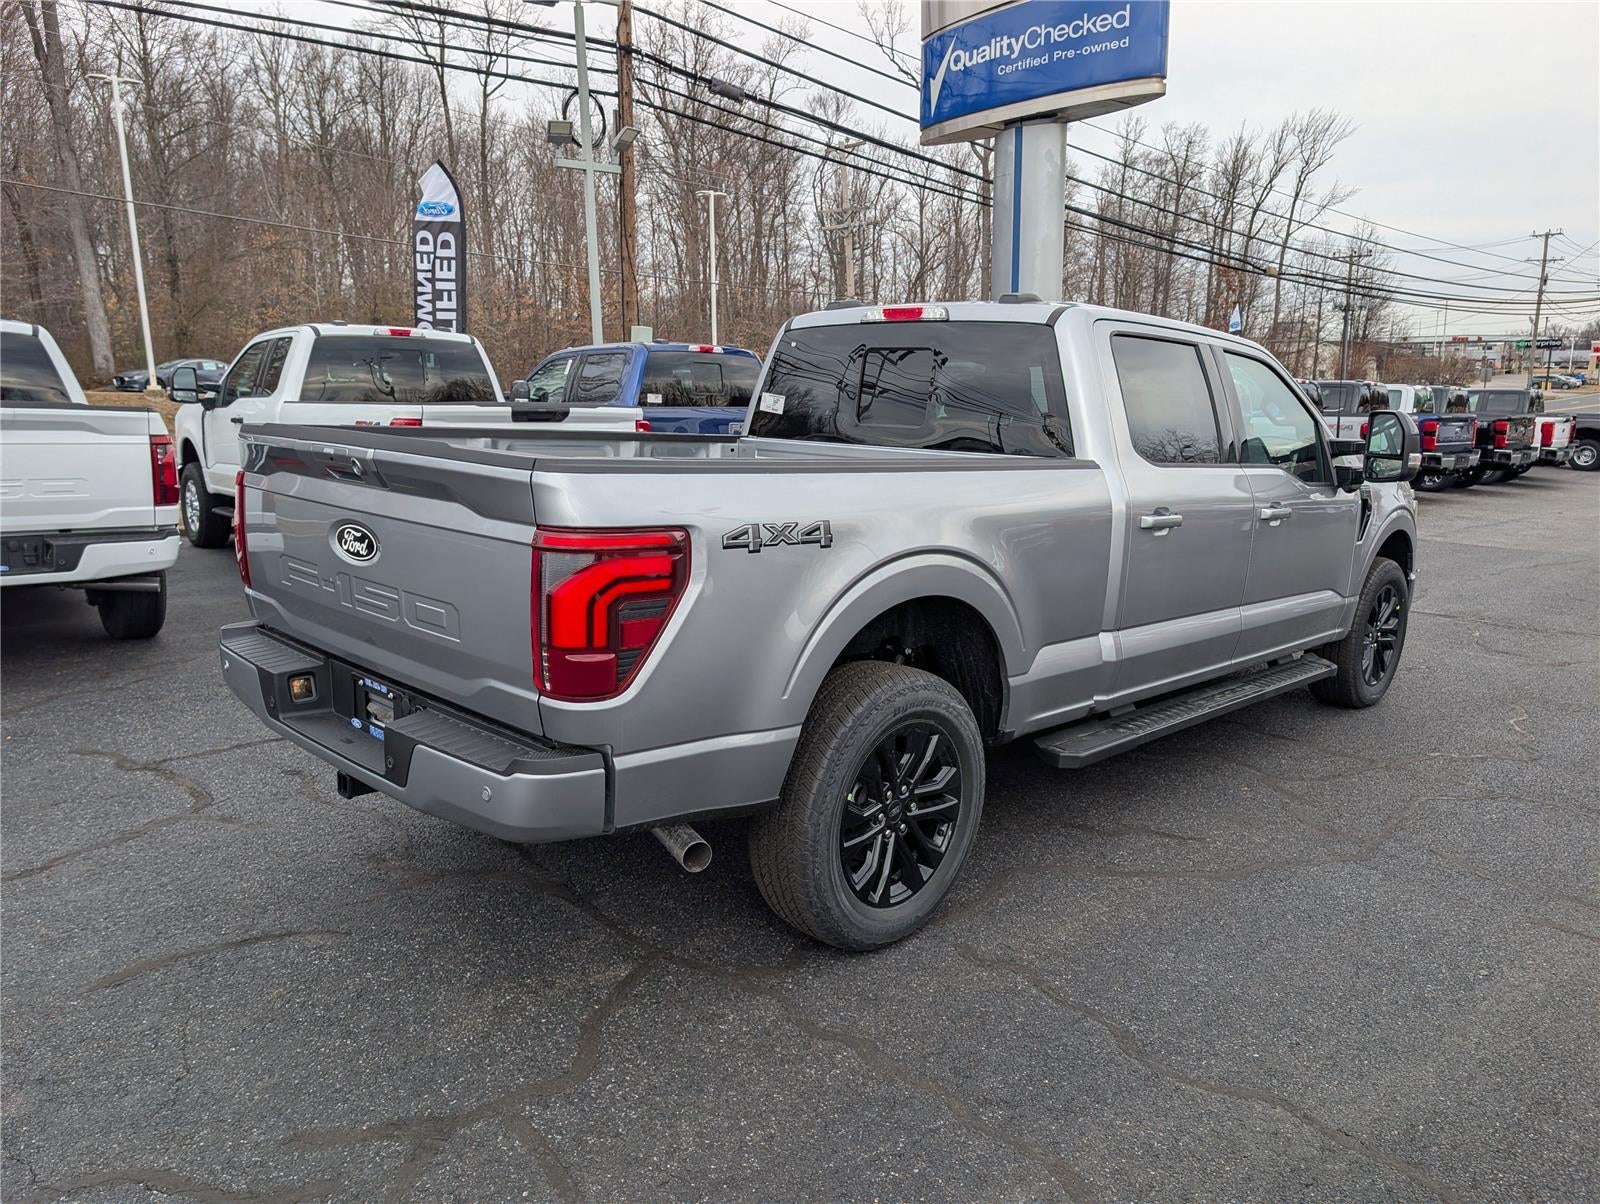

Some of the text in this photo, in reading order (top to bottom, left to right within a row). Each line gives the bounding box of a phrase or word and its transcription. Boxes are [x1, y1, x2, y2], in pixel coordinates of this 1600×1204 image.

[950, 4, 1130, 71] QualityChecked
[997, 36, 1129, 75] Certified Pre-owned
[1519, 339, 1562, 348] enrprise
[341, 528, 369, 556] Ford
[280, 554, 461, 642] F-150
